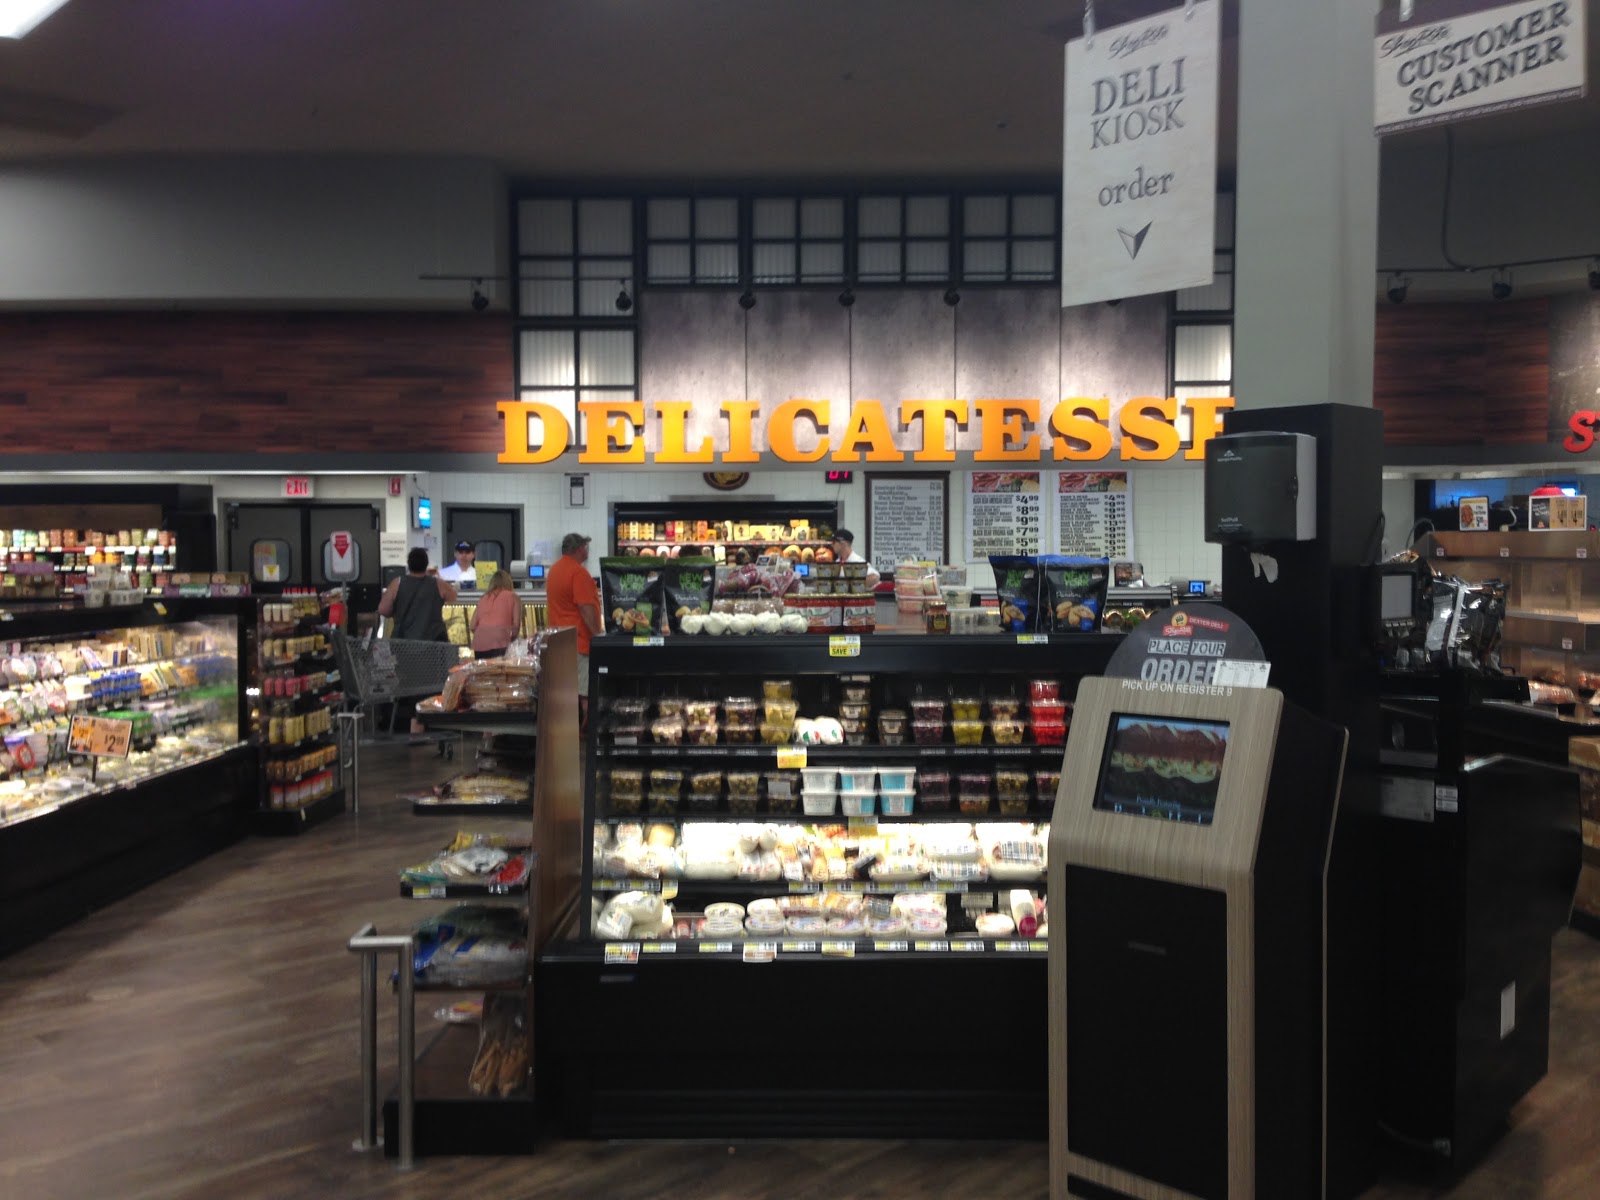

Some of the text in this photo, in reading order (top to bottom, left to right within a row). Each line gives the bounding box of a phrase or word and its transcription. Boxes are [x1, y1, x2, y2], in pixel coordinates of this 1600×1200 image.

[1397, 1, 1572, 88] CUSTOMER
[1091, 56, 1187, 116] DELI
[1408, 34, 1569, 115] SCANNER
[1090, 97, 1185, 150] KIOSK
[1098, 165, 1174, 207] order
[287, 477, 308, 495] EXIT
[1149, 640, 1225, 656] PLACE YOUR
[1122, 680, 1233, 696] PICK UP ON REGISTER 9
